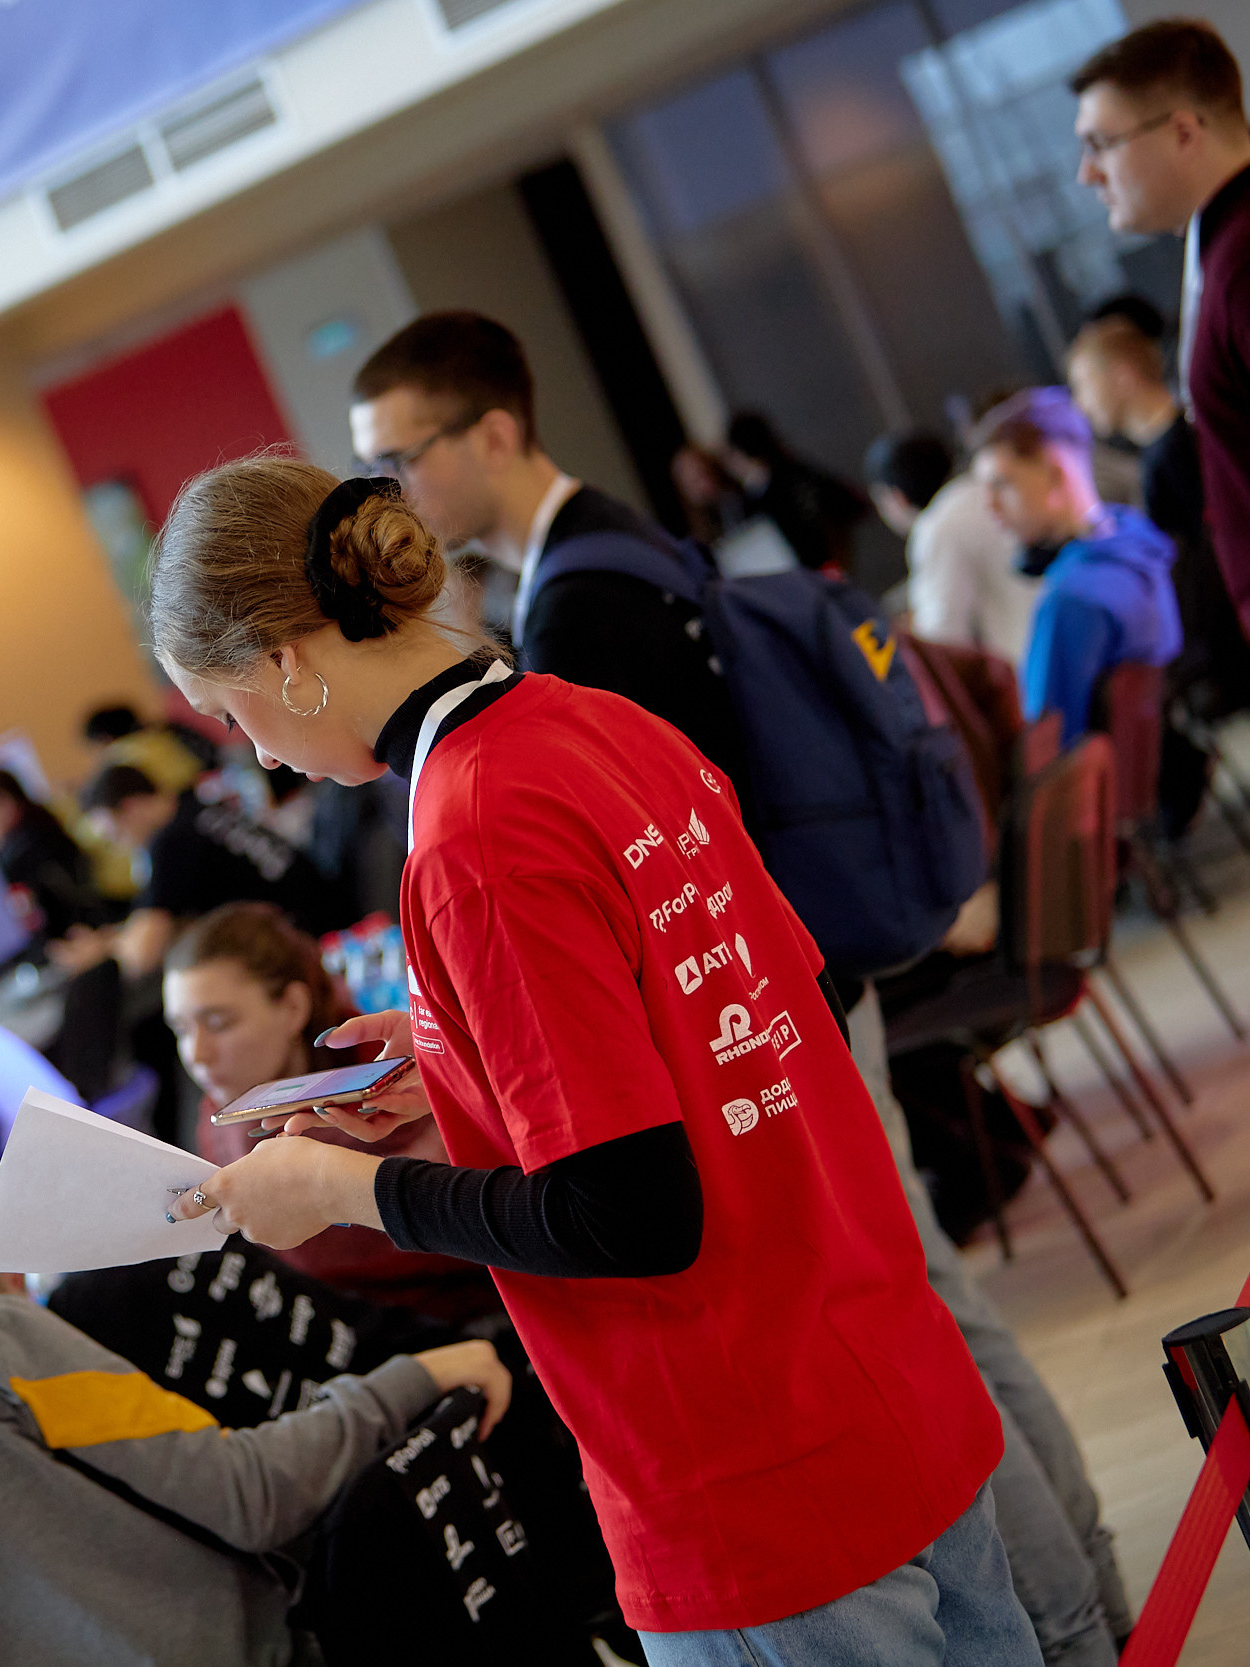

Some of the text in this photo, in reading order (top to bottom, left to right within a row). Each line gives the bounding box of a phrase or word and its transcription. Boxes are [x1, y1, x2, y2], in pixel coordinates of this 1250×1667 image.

[623, 823, 664, 870] DNS
[661, 882, 700, 922] FarP
[715, 1030, 771, 1066] RHOND
[759, 1076, 792, 1104] ДОД
[764, 1091, 798, 1118] ПИЦ
